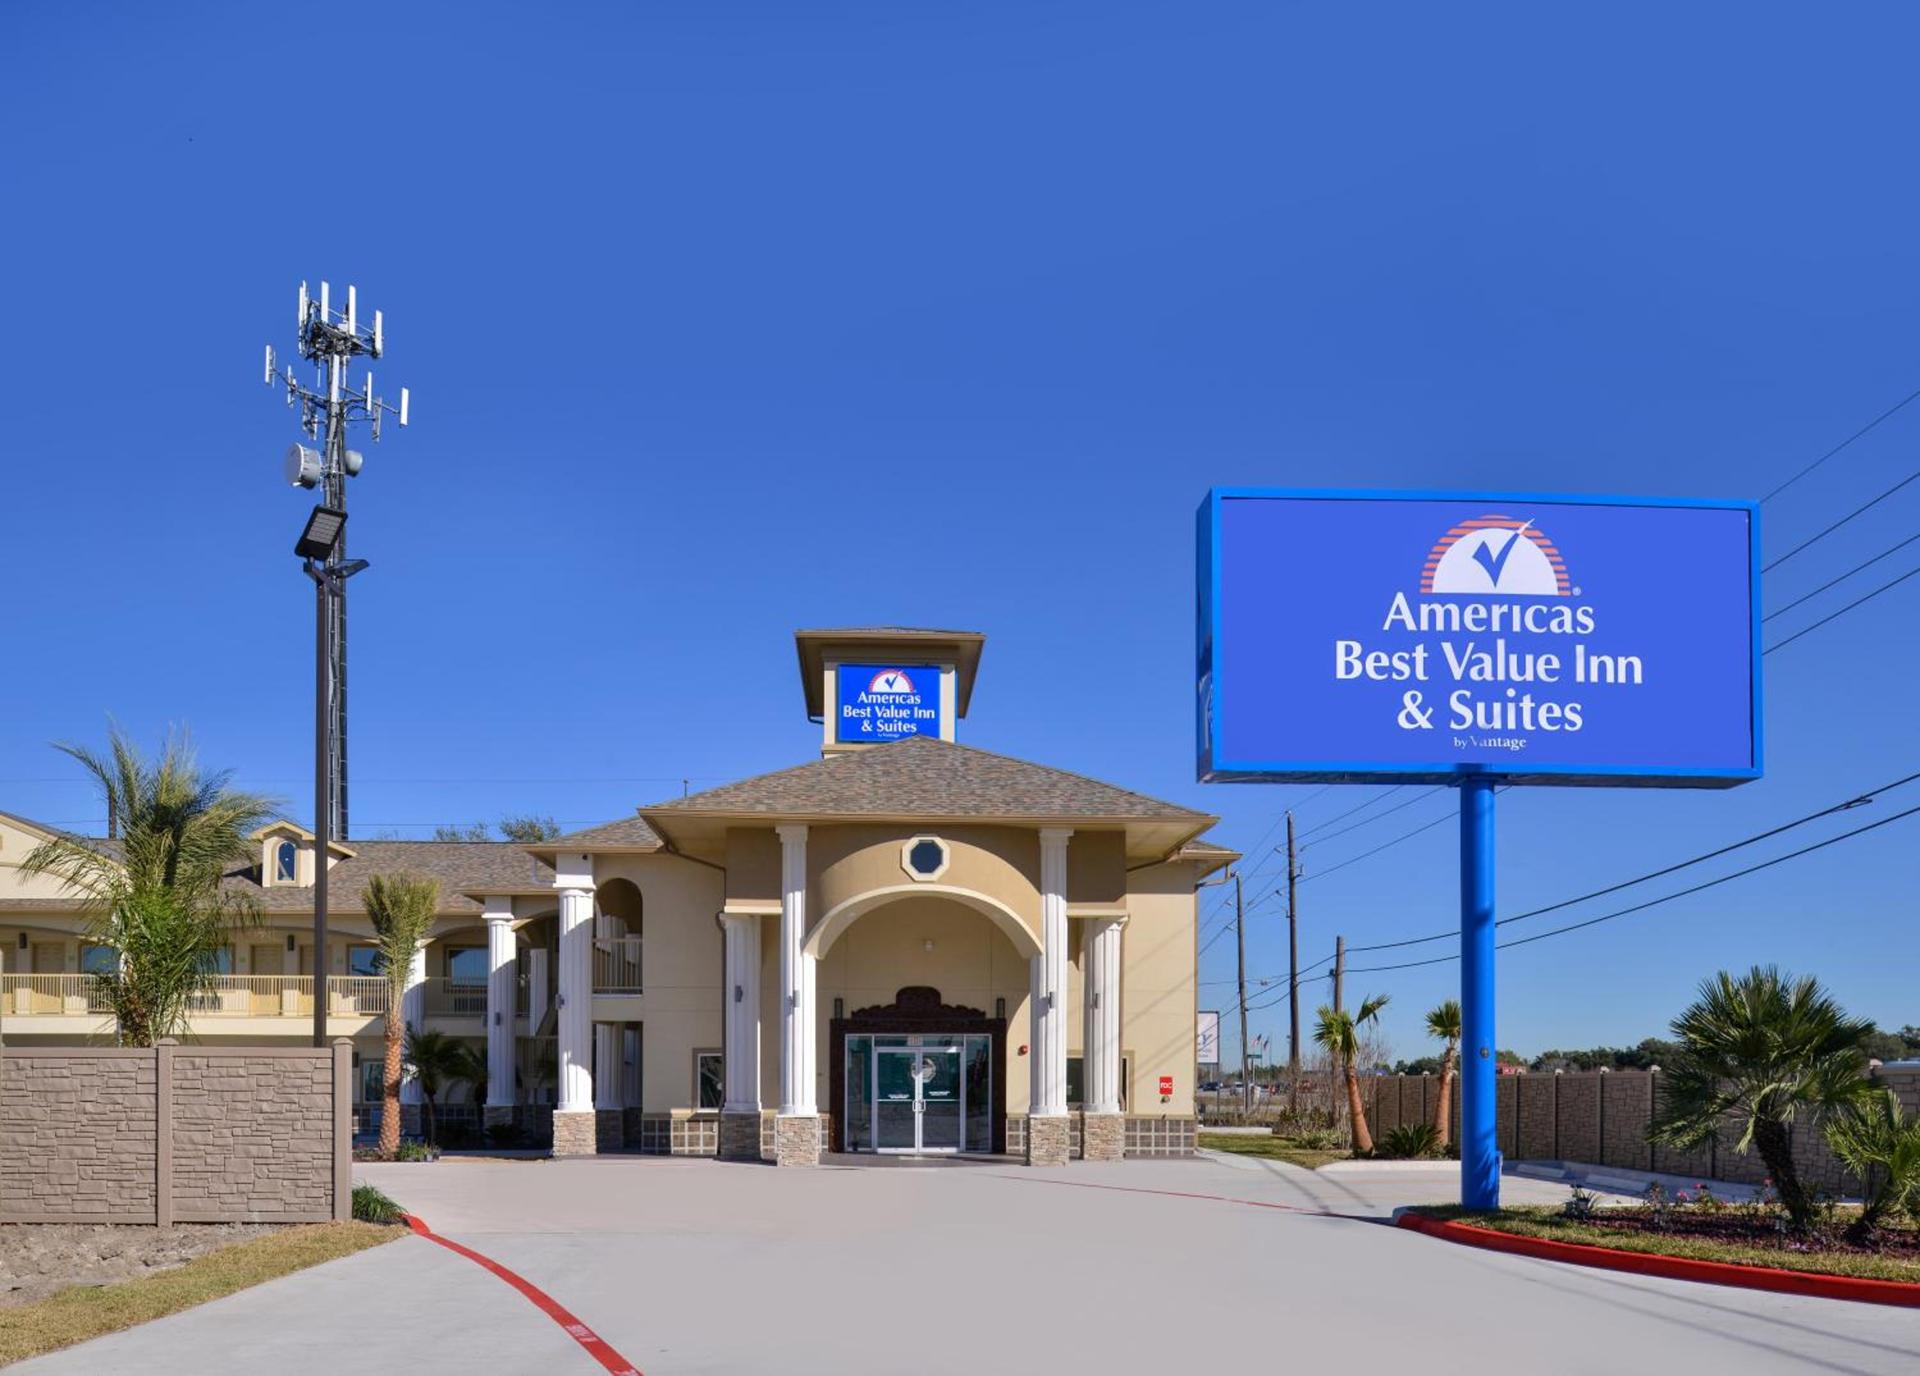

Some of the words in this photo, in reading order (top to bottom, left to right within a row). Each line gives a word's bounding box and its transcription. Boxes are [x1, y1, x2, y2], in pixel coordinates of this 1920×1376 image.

[1382, 591, 1595, 635] Americas
[1335, 640, 1429, 682] Best
[1440, 639, 1561, 683] Value
[1575, 644, 1643, 685] Inn
[857, 691, 921, 704] Americas
[843, 705, 871, 718] Best
[875, 705, 910, 718] Value
[914, 707, 935, 719] Inn
[1397, 689, 1434, 731] &
[1449, 688, 1583, 732] Suites
[861, 719, 873, 732] &
[876, 719, 917, 732] Suites
[1453, 736, 1467, 750] by
[1469, 736, 1527, 751] Vantage
